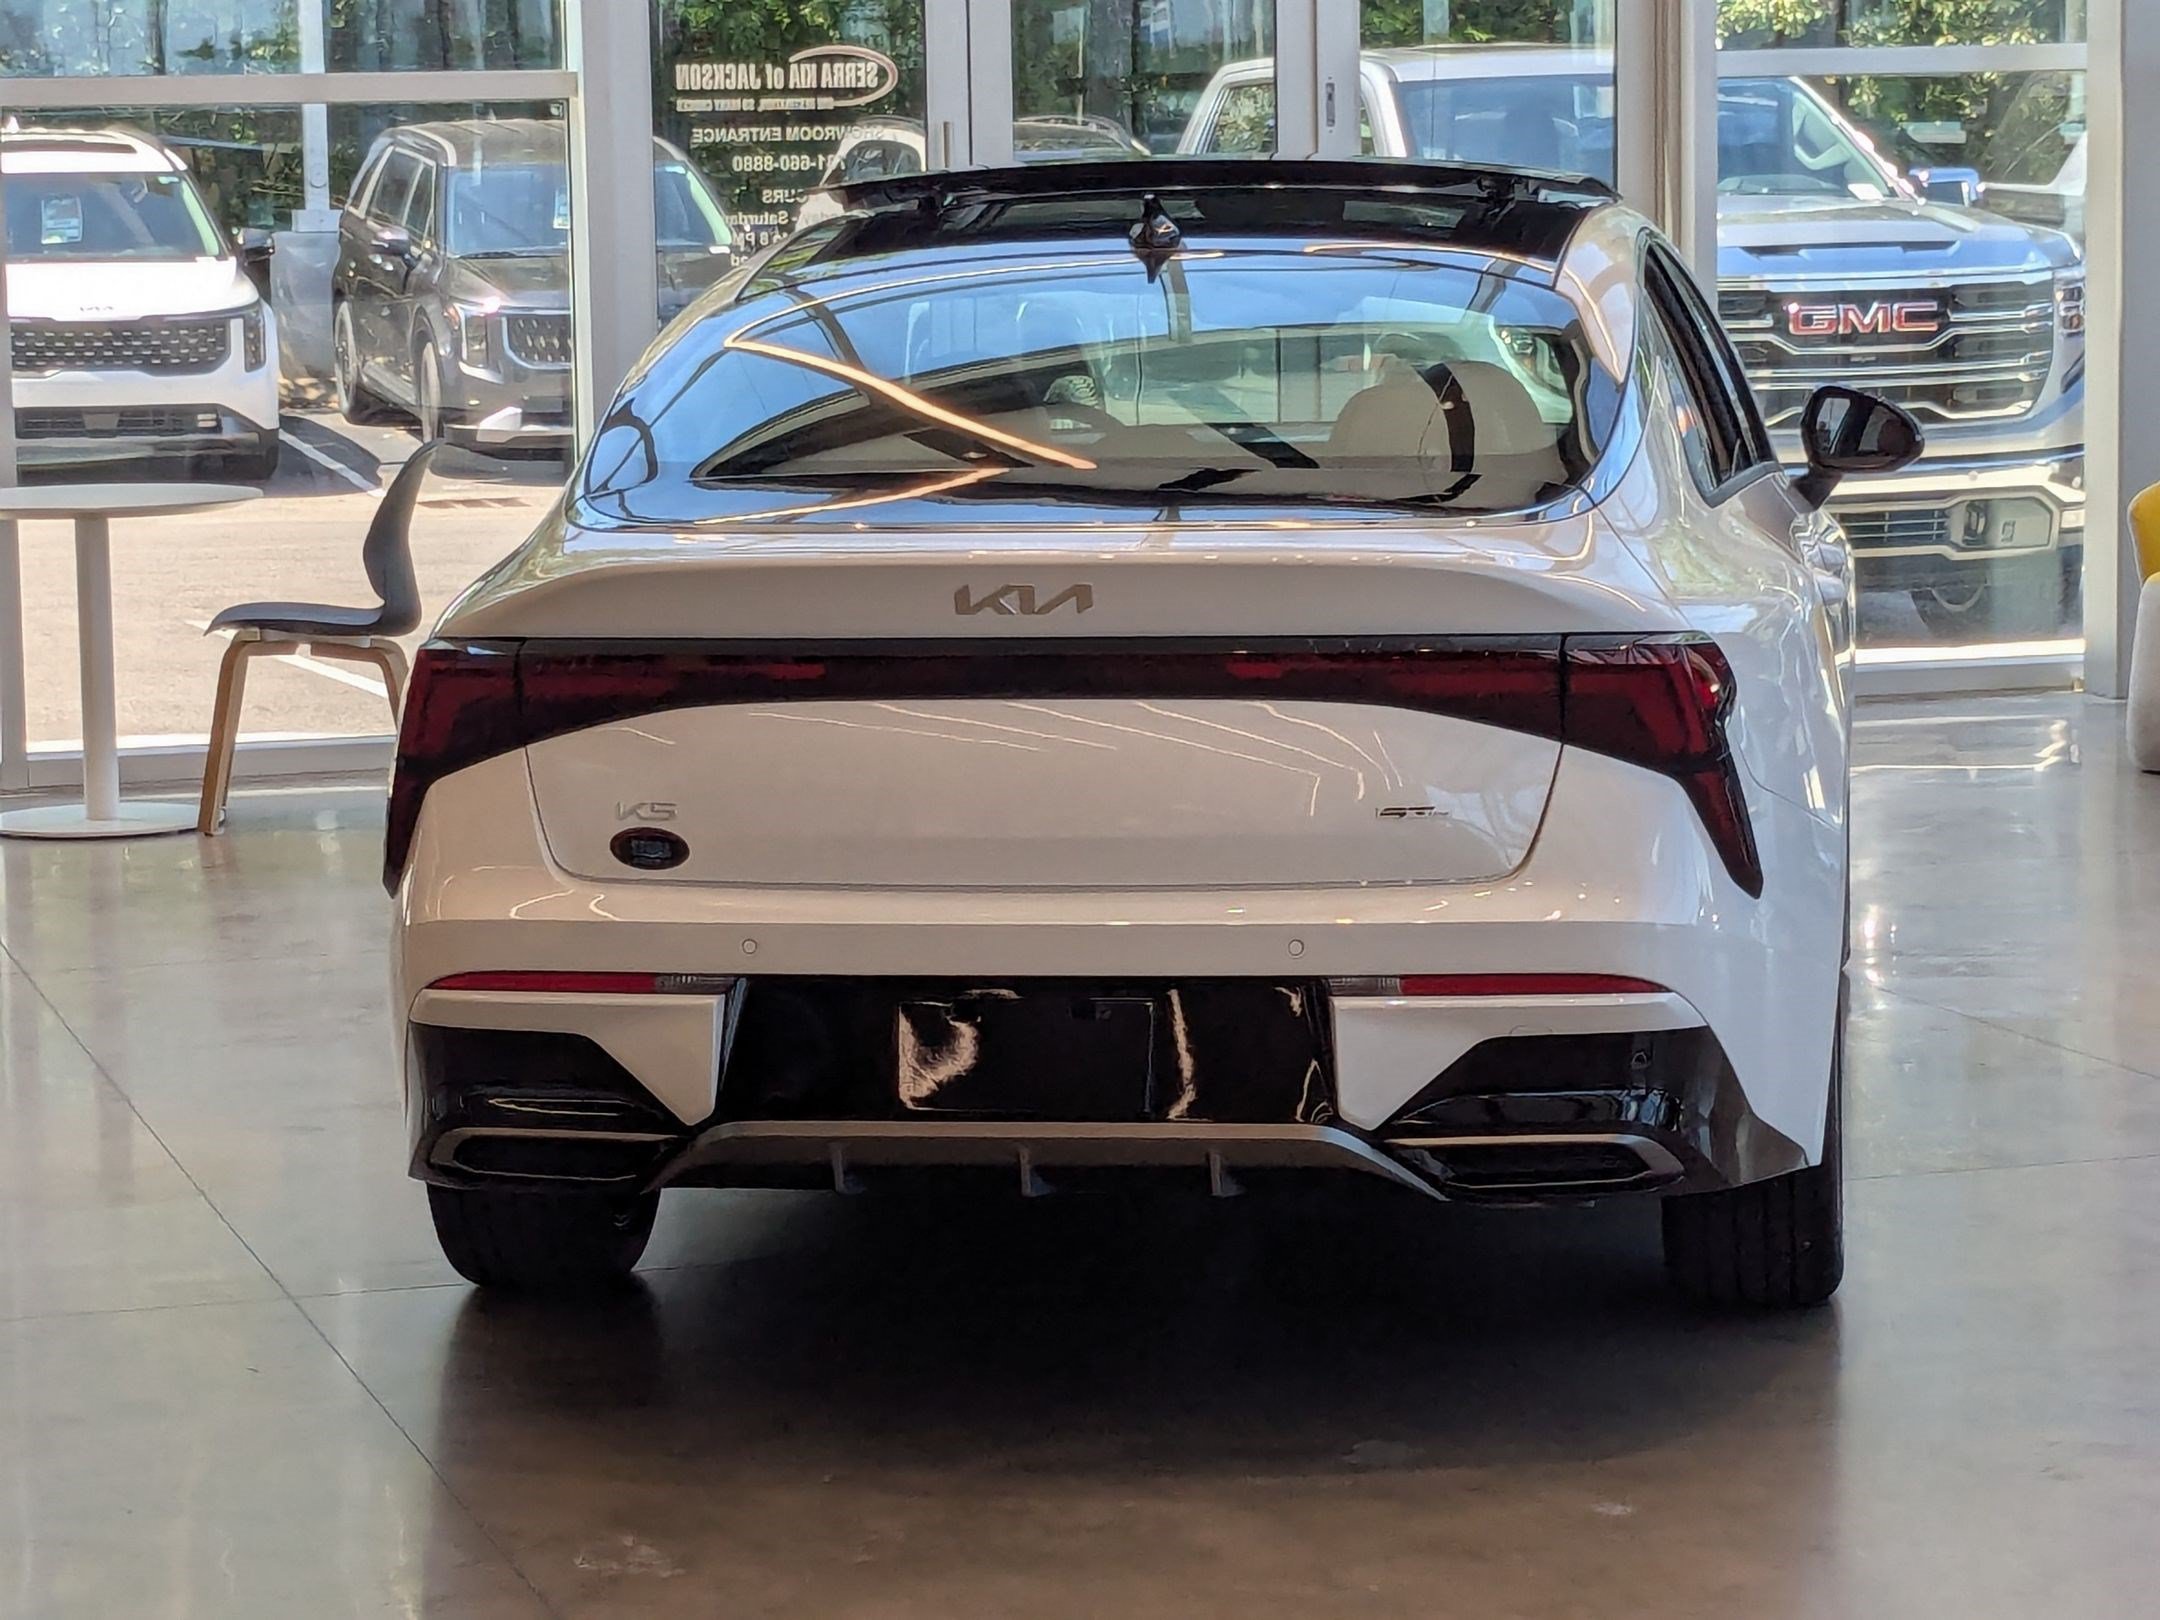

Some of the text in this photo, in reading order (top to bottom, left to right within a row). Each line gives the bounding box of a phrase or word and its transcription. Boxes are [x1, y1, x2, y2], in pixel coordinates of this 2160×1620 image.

[1787, 301, 1939, 336] GMC
[954, 584, 1093, 615] KIA
[615, 801, 678, 820] K5
